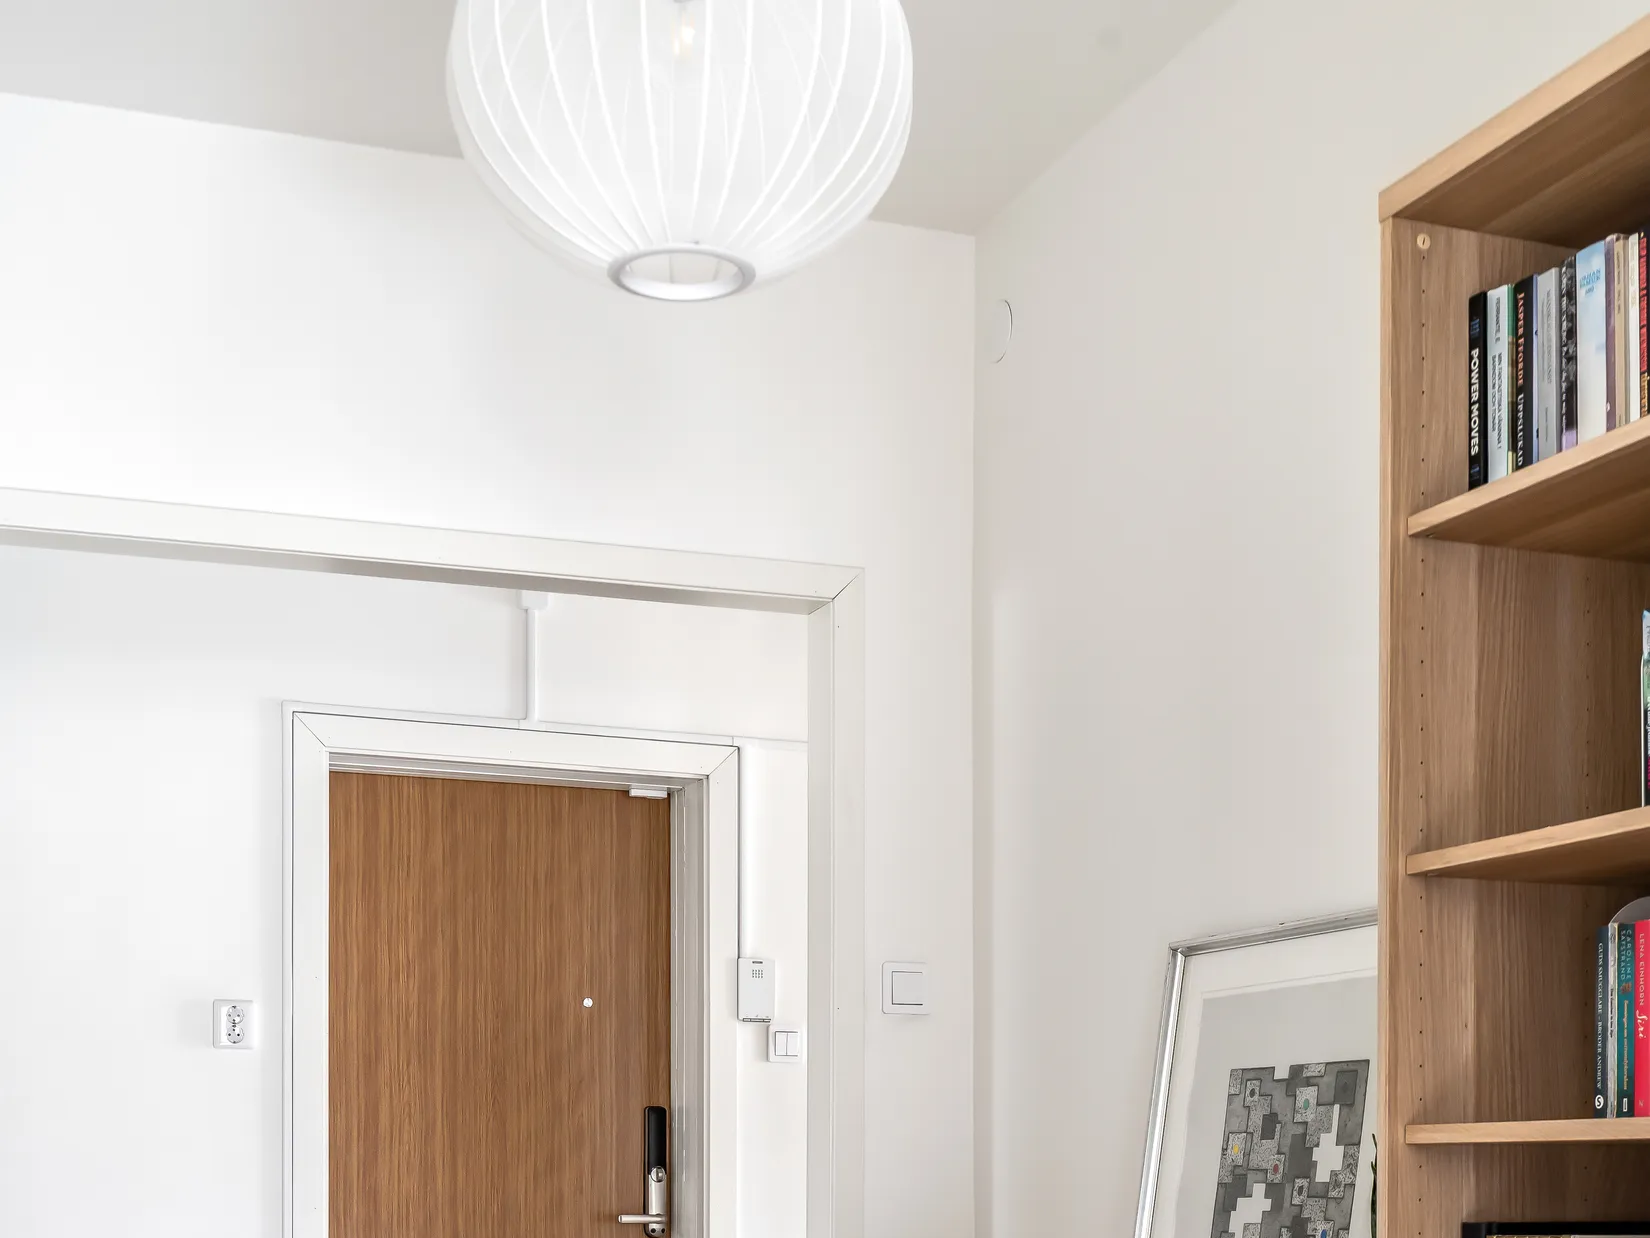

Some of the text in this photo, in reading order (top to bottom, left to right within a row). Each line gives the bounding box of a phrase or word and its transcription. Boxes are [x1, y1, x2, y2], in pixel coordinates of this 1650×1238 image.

[1517, 292, 1525, 336] JASPER
[1517, 337, 1525, 387] FFORDE
[1470, 348, 1479, 456] POWER MOVES
[1636, 1009, 1648, 1039] Siri
